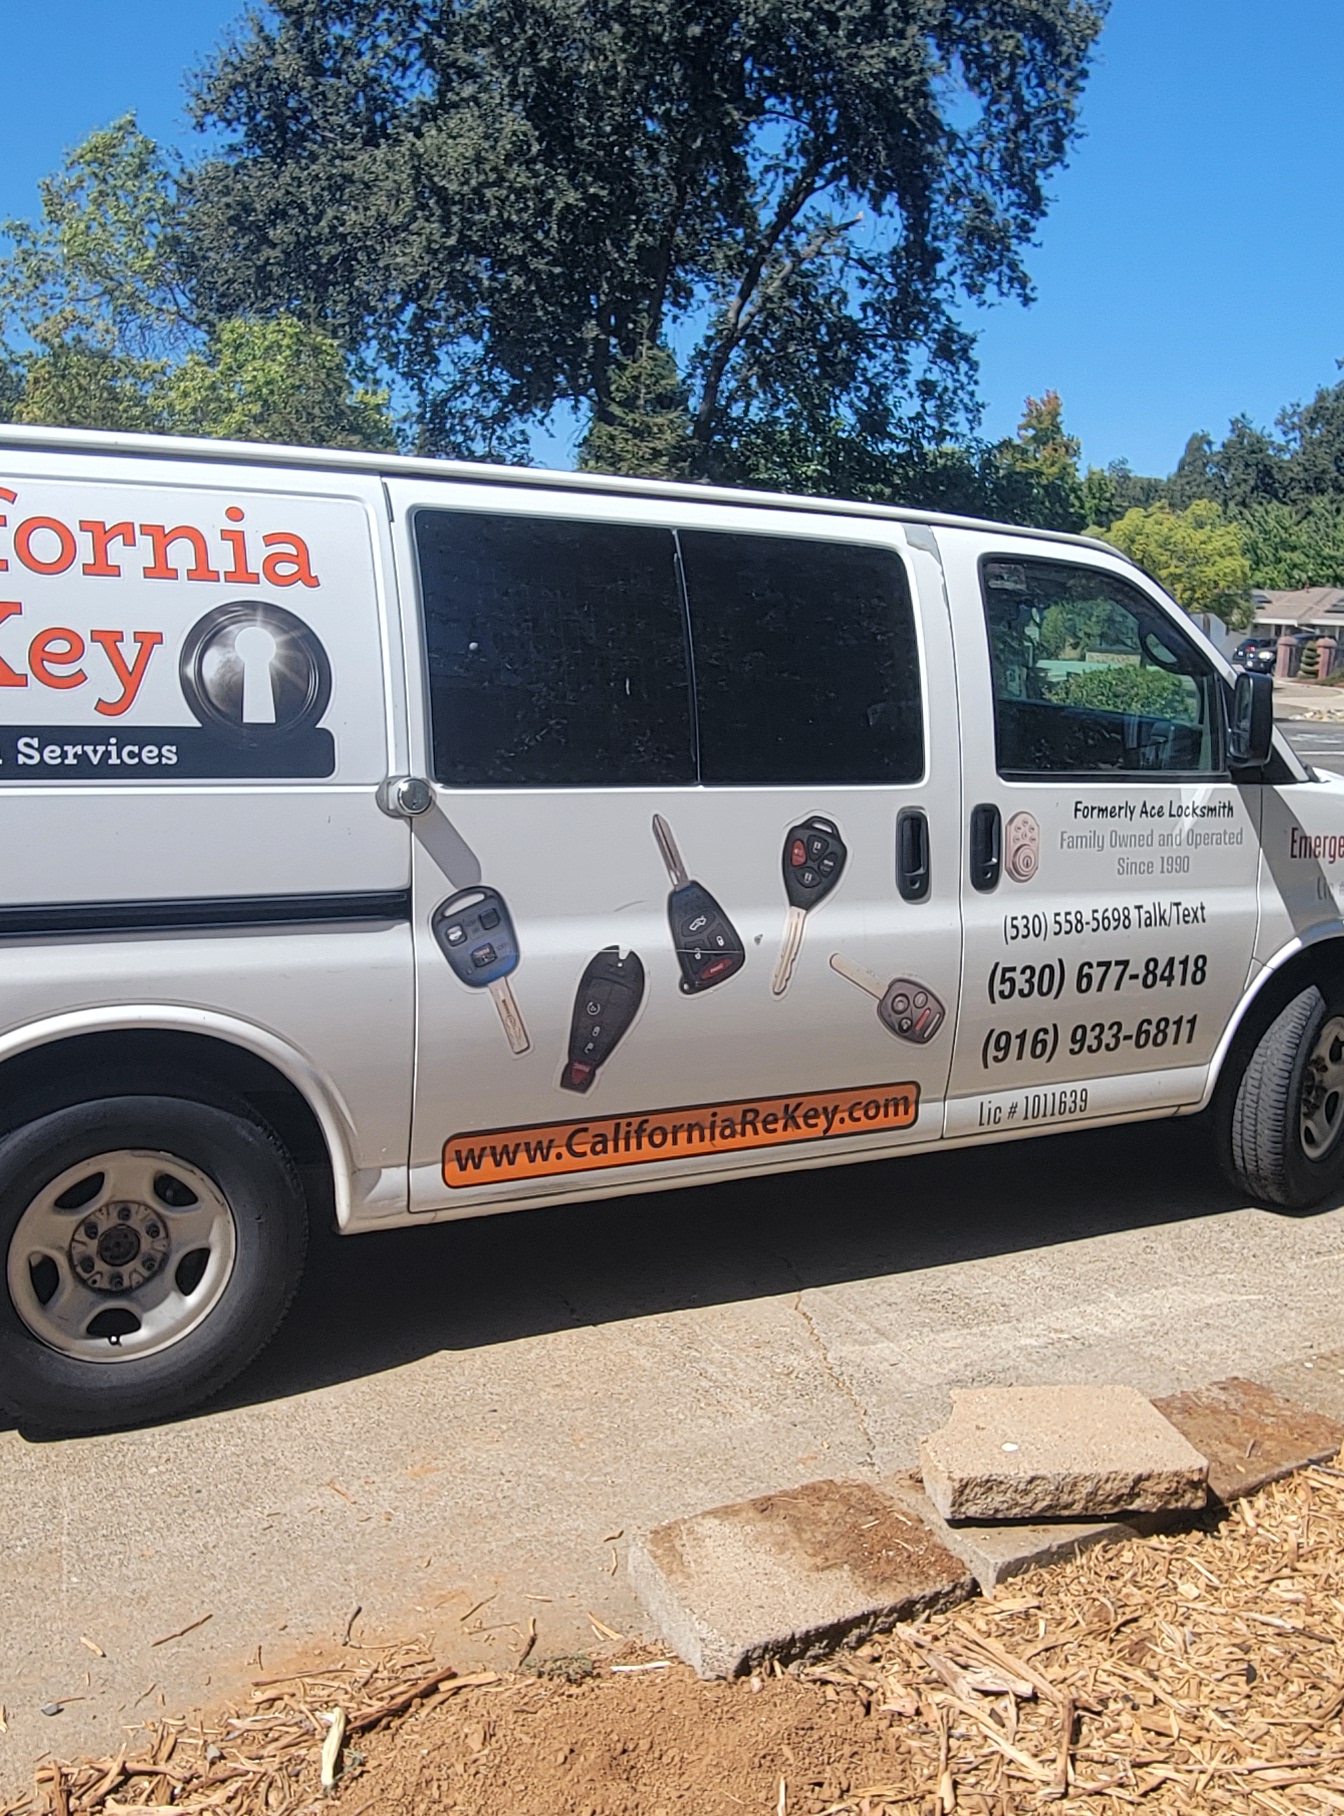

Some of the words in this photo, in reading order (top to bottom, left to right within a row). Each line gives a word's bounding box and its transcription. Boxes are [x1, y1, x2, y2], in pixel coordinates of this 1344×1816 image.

[16, 736, 179, 767] Services
[1074, 801, 1135, 821] Formerly
[1139, 801, 1165, 819] Ace
[1168, 800, 1234, 819] Locksmith
[1059, 830, 1105, 852] Family
[1109, 829, 1154, 849] Owned
[1158, 828, 1181, 848] and
[1186, 827, 1244, 850] Operated
[1116, 857, 1154, 876] Since
[1159, 855, 1190, 874] 1990
[1002, 911, 1049, 945] (530)
[1052, 906, 1132, 938] 558-5698
[1135, 901, 1207, 930] Talk/Text
[987, 957, 1066, 1004] (530)
[1075, 954, 1208, 994] 677-8418
[981, 1022, 1060, 1069] (916)
[1068, 1014, 1198, 1056] 933-6811
[978, 1100, 1003, 1127] Lic
[1006, 1100, 1019, 1121] #
[1022, 1088, 1089, 1121] 1011639
[454, 1090, 911, 1173] www.CaliforniaReKey.com
